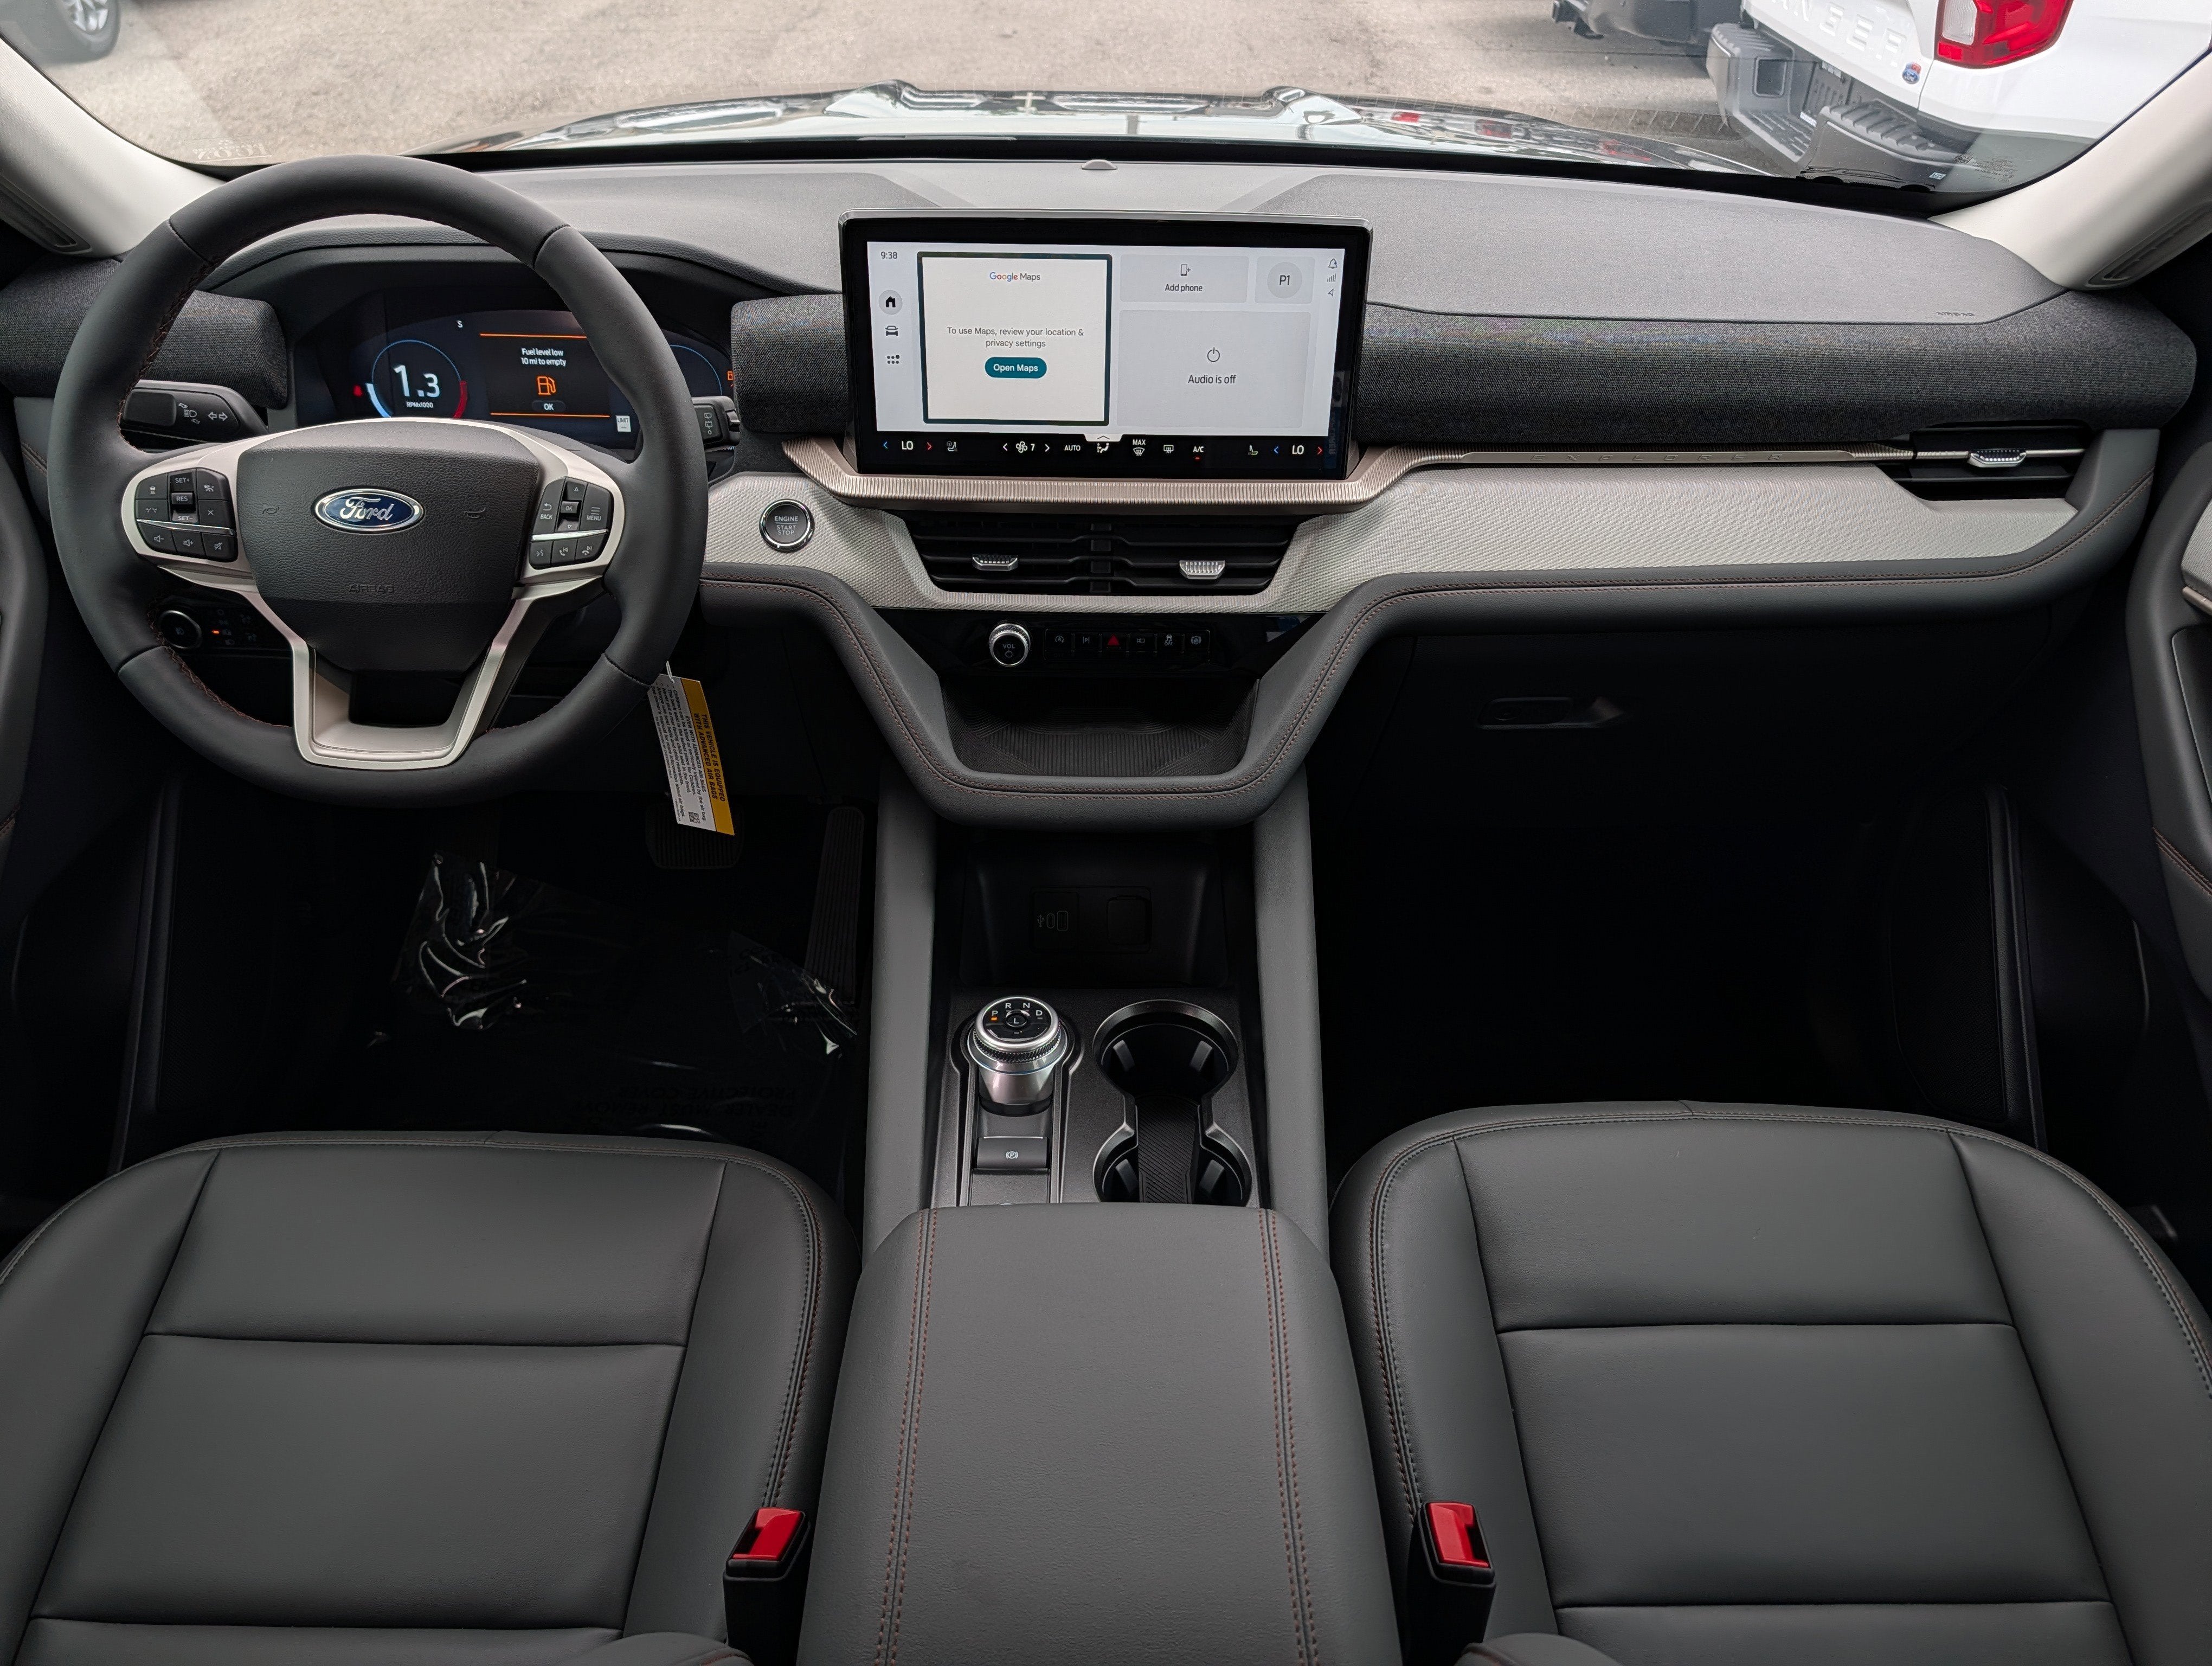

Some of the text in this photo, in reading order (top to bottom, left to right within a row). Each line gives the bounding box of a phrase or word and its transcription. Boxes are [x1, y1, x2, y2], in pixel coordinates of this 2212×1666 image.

[1771, 0, 1908, 67] NGER
[880, 251, 898, 260] 9:38
[989, 271, 1041, 282] Google Maps
[1279, 275, 1291, 286] P1
[1165, 284, 1203, 293] Add phone
[947, 326, 957, 335] To
[975, 327, 998, 336] Maps,
[999, 328, 1024, 336] review
[1026, 329, 1043, 337] your
[1045, 328, 1076, 336] location
[985, 339, 1046, 348] privacy settings
[522, 348, 536, 356] Fuel
[536, 348, 551, 356] level
[521, 357, 529, 365] 10
[545, 358, 567, 367] empty
[993, 363, 1038, 373] Open Maps
[393, 364, 441, 398] 1.3
[1188, 374, 1236, 384] Audio is off
[543, 403, 555, 411] OK
[902, 440, 914, 451] LO
[1030, 443, 1035, 451] 7
[1292, 445, 1304, 455] LO
[339, 496, 395, 521] Ford
[348, 583, 395, 593] AIRBAG
[691, 742, 702, 769] ADVANCED
[693, 712, 718, 799] WITH ADVANCED AIR BAGS
[700, 713, 710, 729] THIS
[705, 731, 717, 759] VEHICLE
[712, 767, 726, 802] EQUIPPED
[687, 748, 697, 771] seriously
[692, 771, 700, 789] injured
